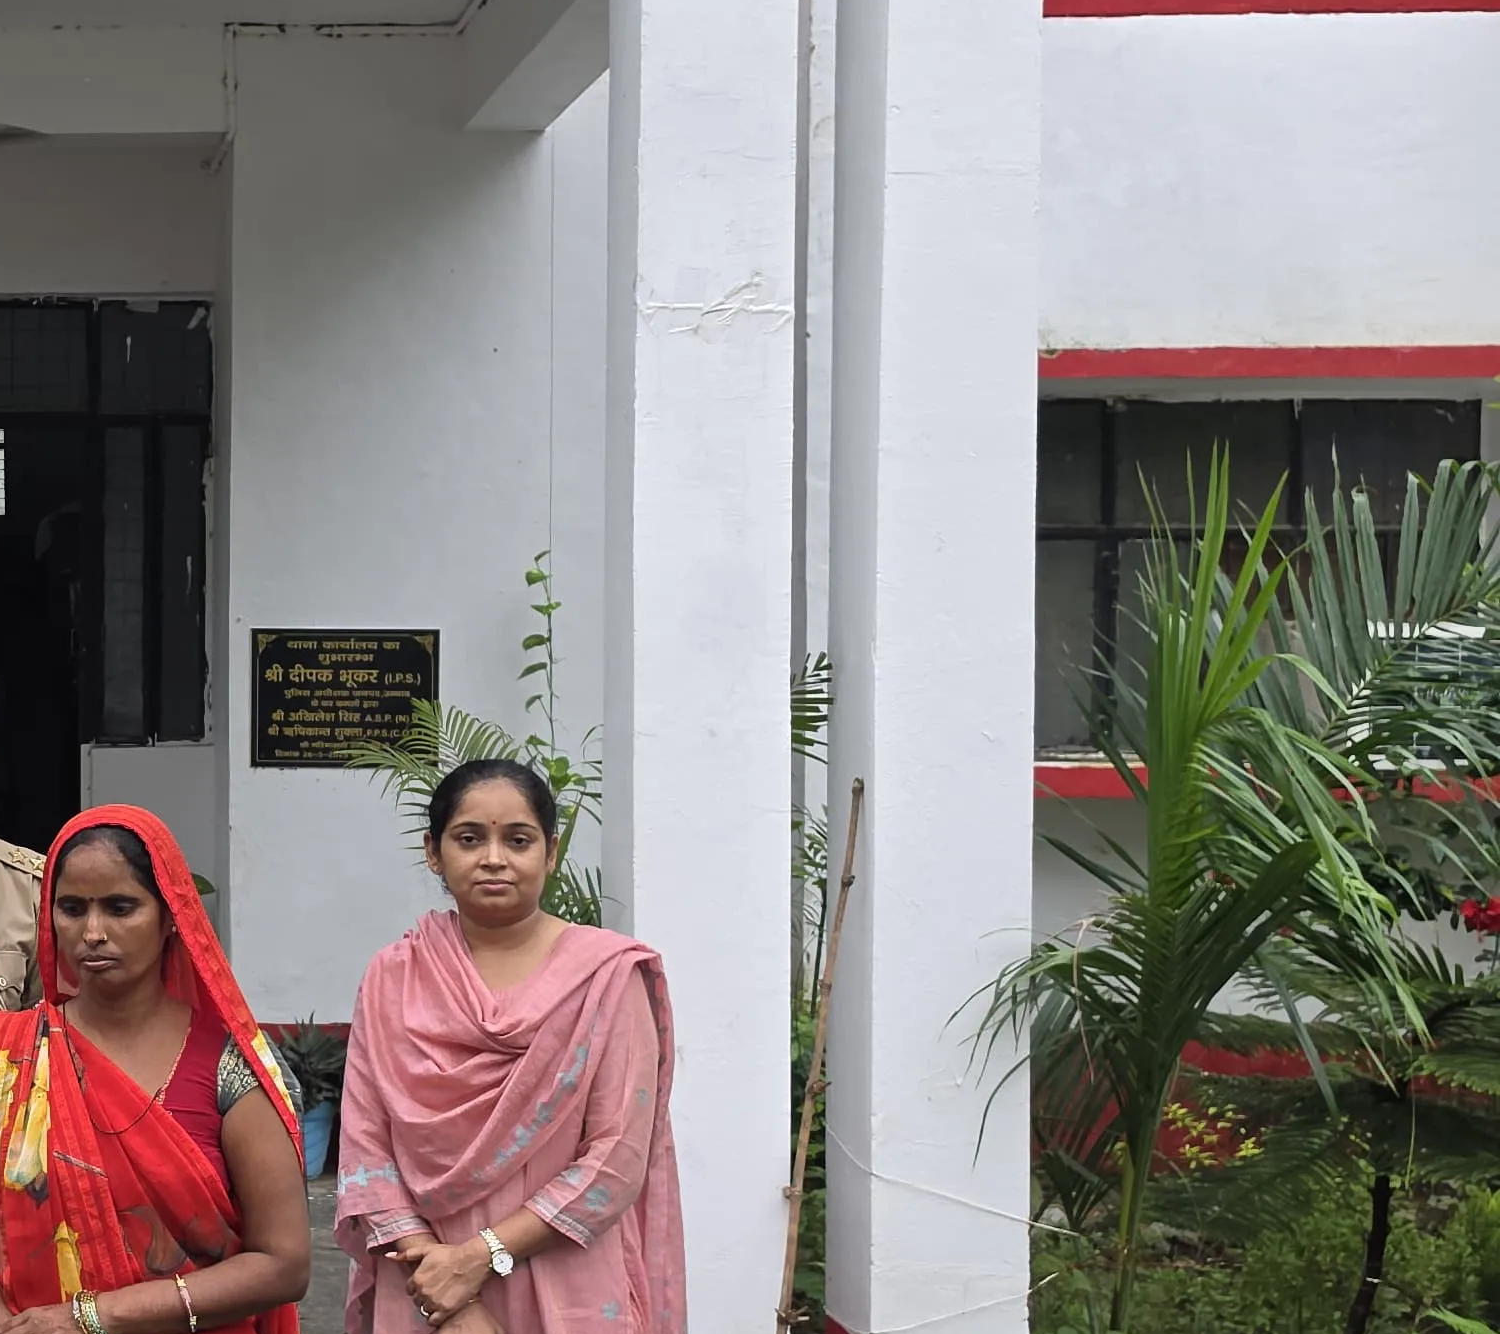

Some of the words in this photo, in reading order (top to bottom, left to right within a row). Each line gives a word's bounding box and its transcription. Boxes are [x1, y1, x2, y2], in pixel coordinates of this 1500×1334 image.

[264, 663, 284, 683] श्री
[288, 663, 334, 684] दीपक
[339, 668, 380, 689] भूकर
[384, 672, 421, 686] (I.P.S.)
